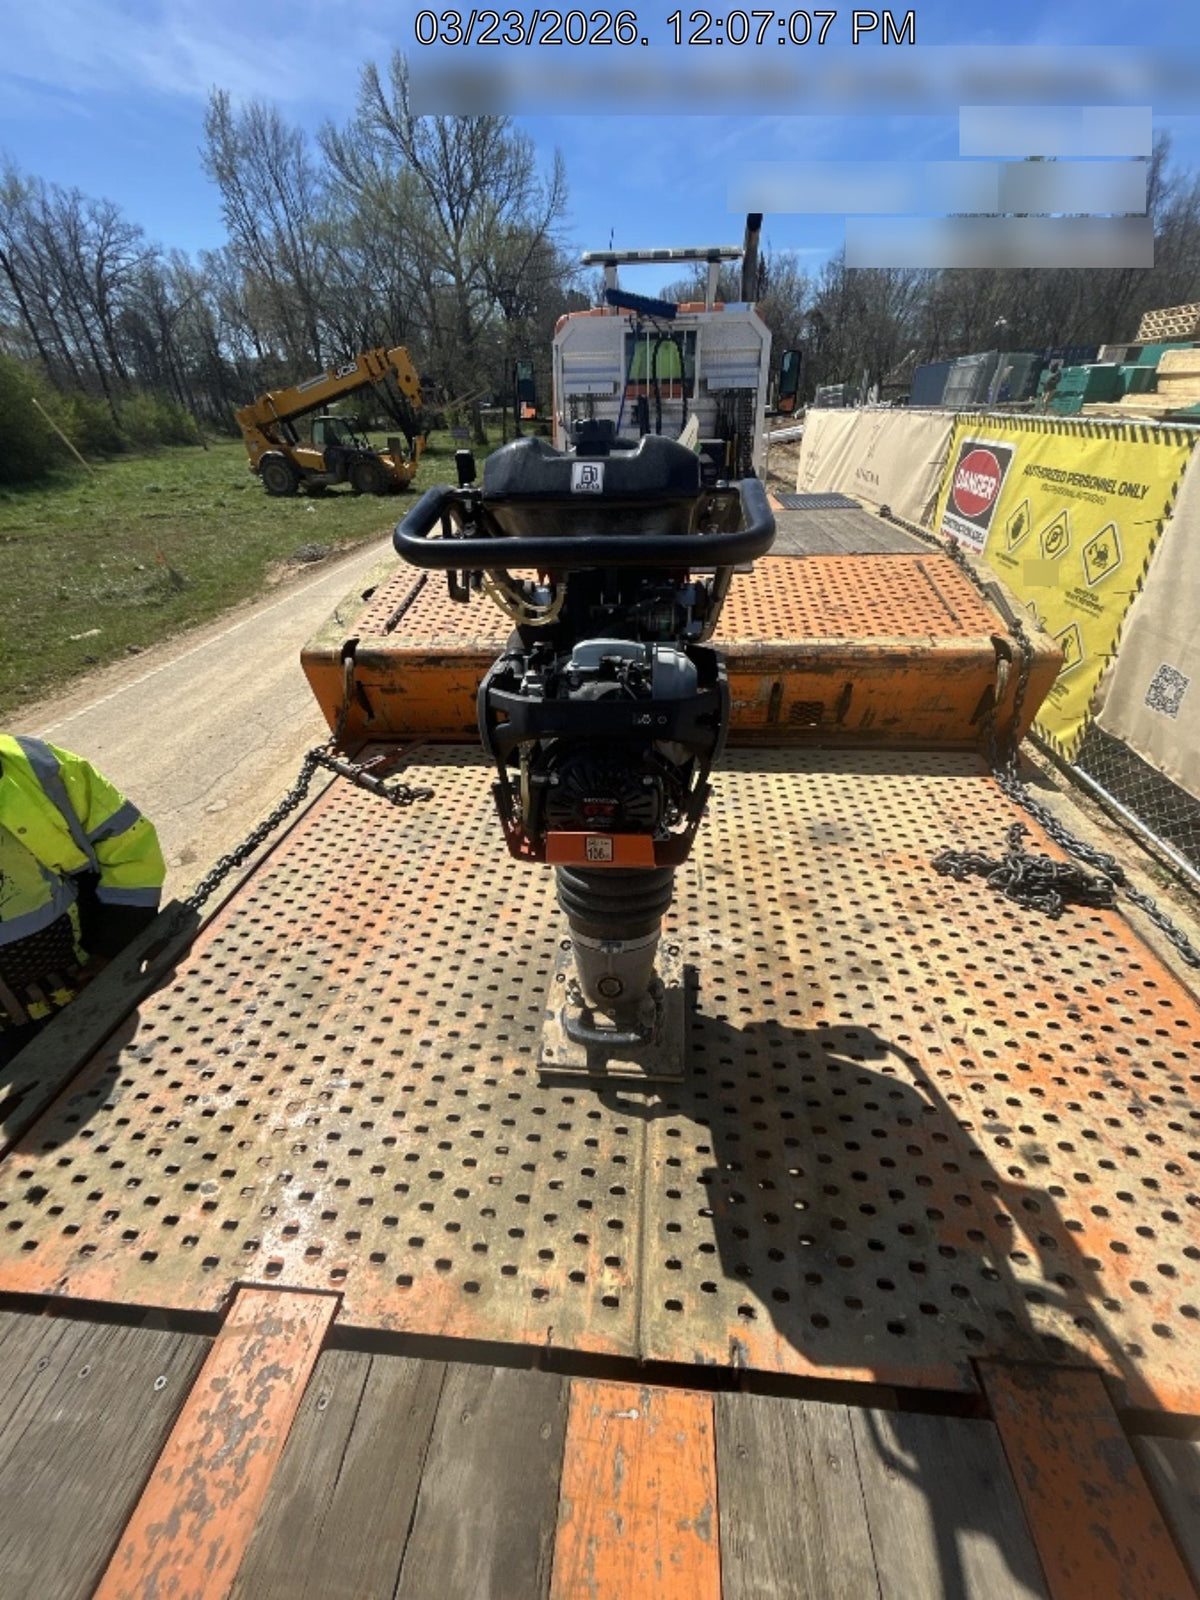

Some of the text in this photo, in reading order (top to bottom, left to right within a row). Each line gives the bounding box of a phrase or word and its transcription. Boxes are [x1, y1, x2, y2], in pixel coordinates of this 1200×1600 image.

[334, 362, 358, 380] JCB
[954, 467, 997, 501] DANGER
[1022, 464, 1068, 484] AUTHORIZED
[1066, 472, 1117, 495] PERSONNEL
[1117, 481, 1150, 500] ONLY
